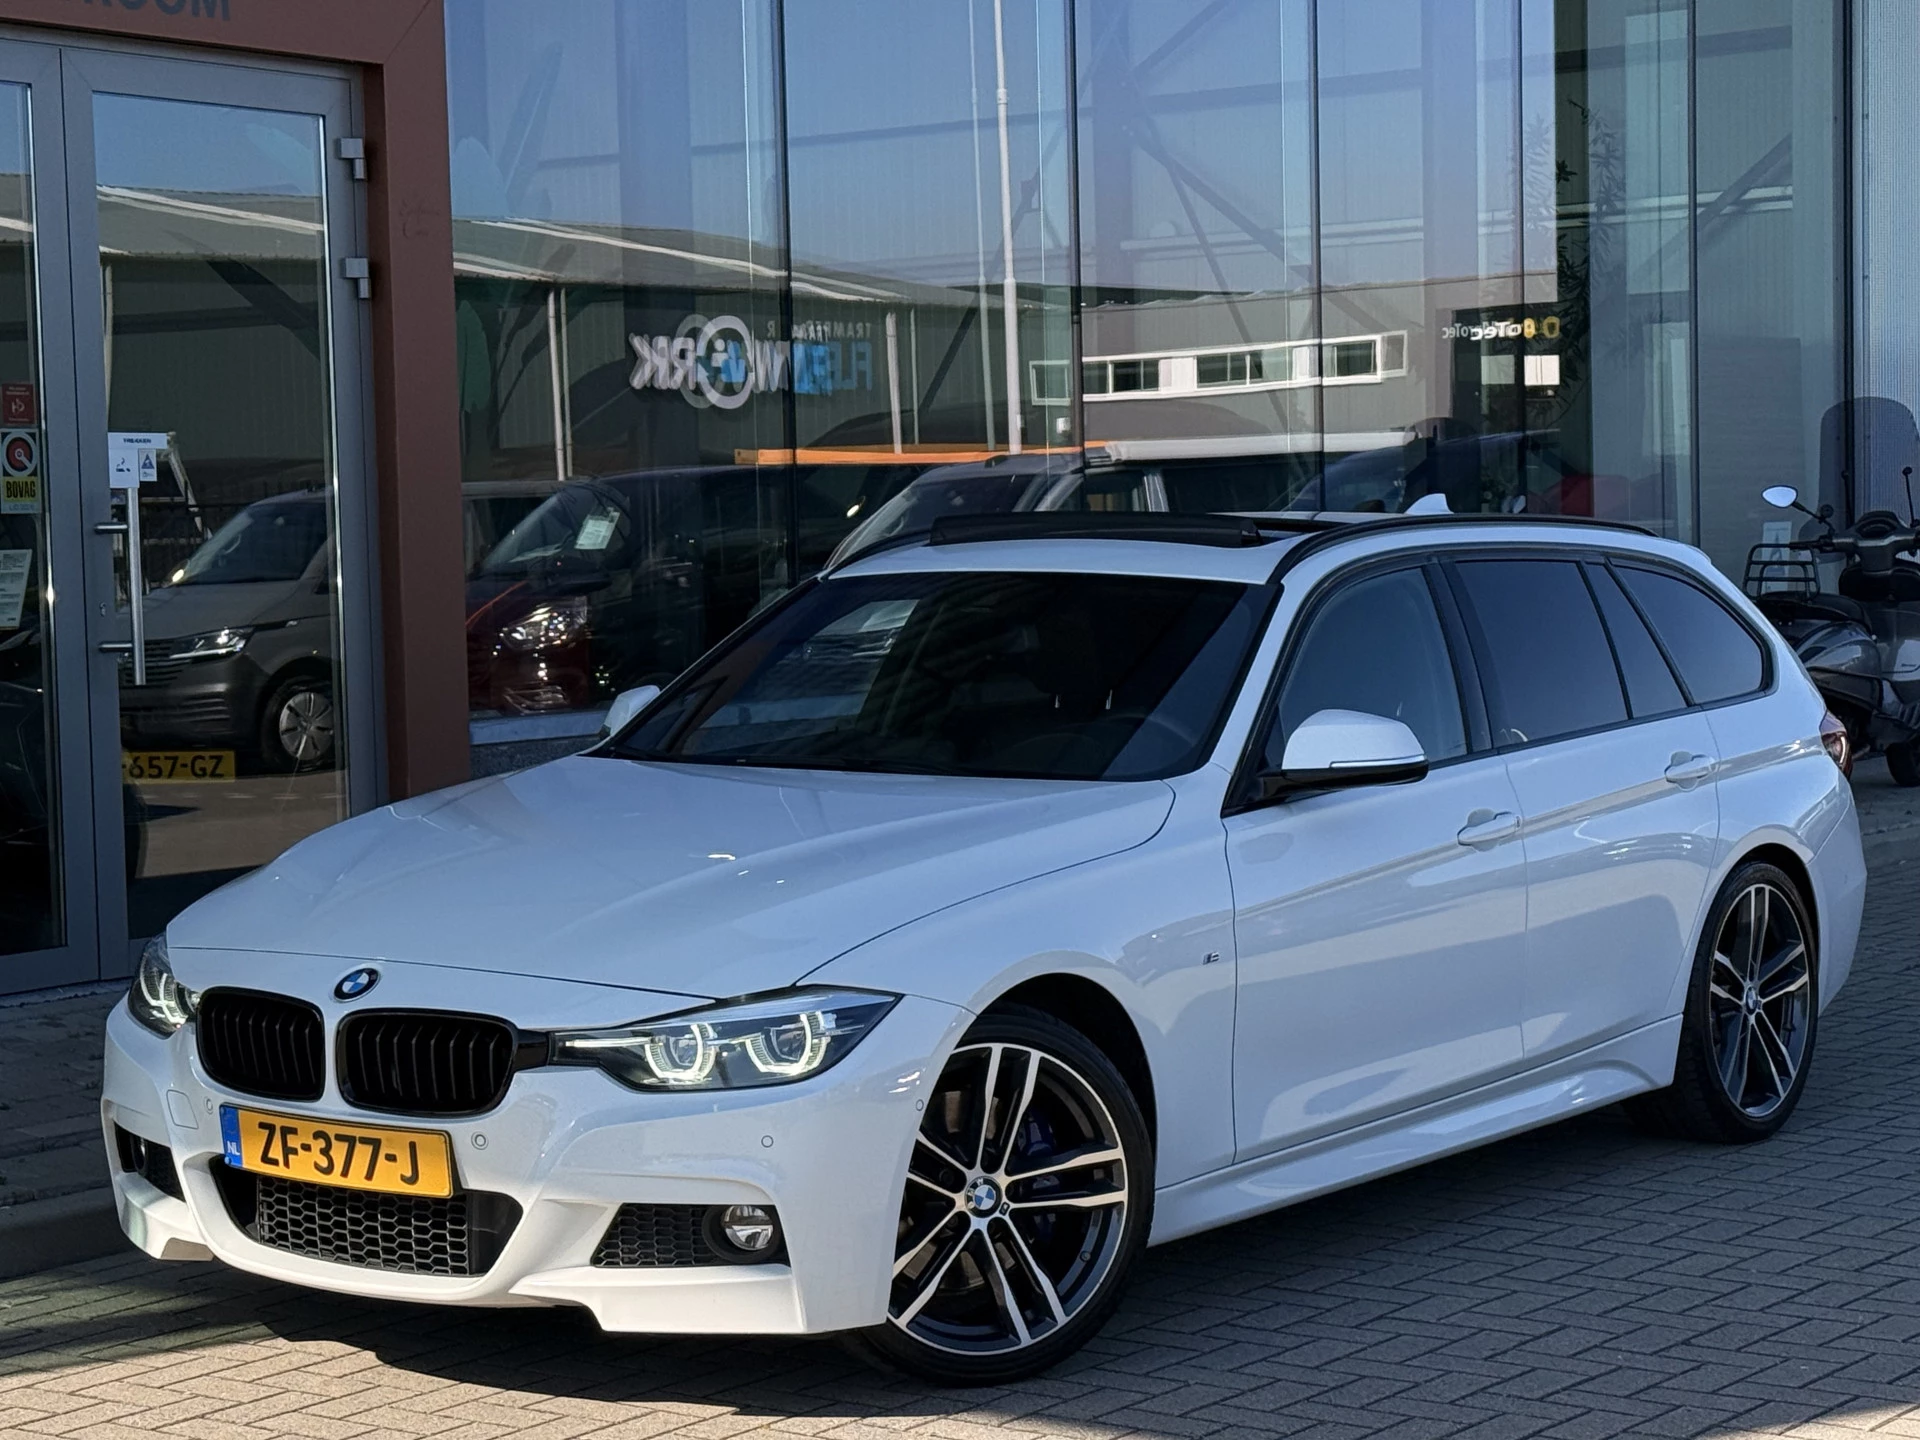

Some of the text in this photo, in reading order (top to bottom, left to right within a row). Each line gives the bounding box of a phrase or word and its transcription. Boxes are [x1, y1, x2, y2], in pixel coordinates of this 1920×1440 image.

[6, 480, 36, 498] BOVAG
[226, 1140, 241, 1156] NL
[258, 1121, 420, 1186] ZF-377-J
